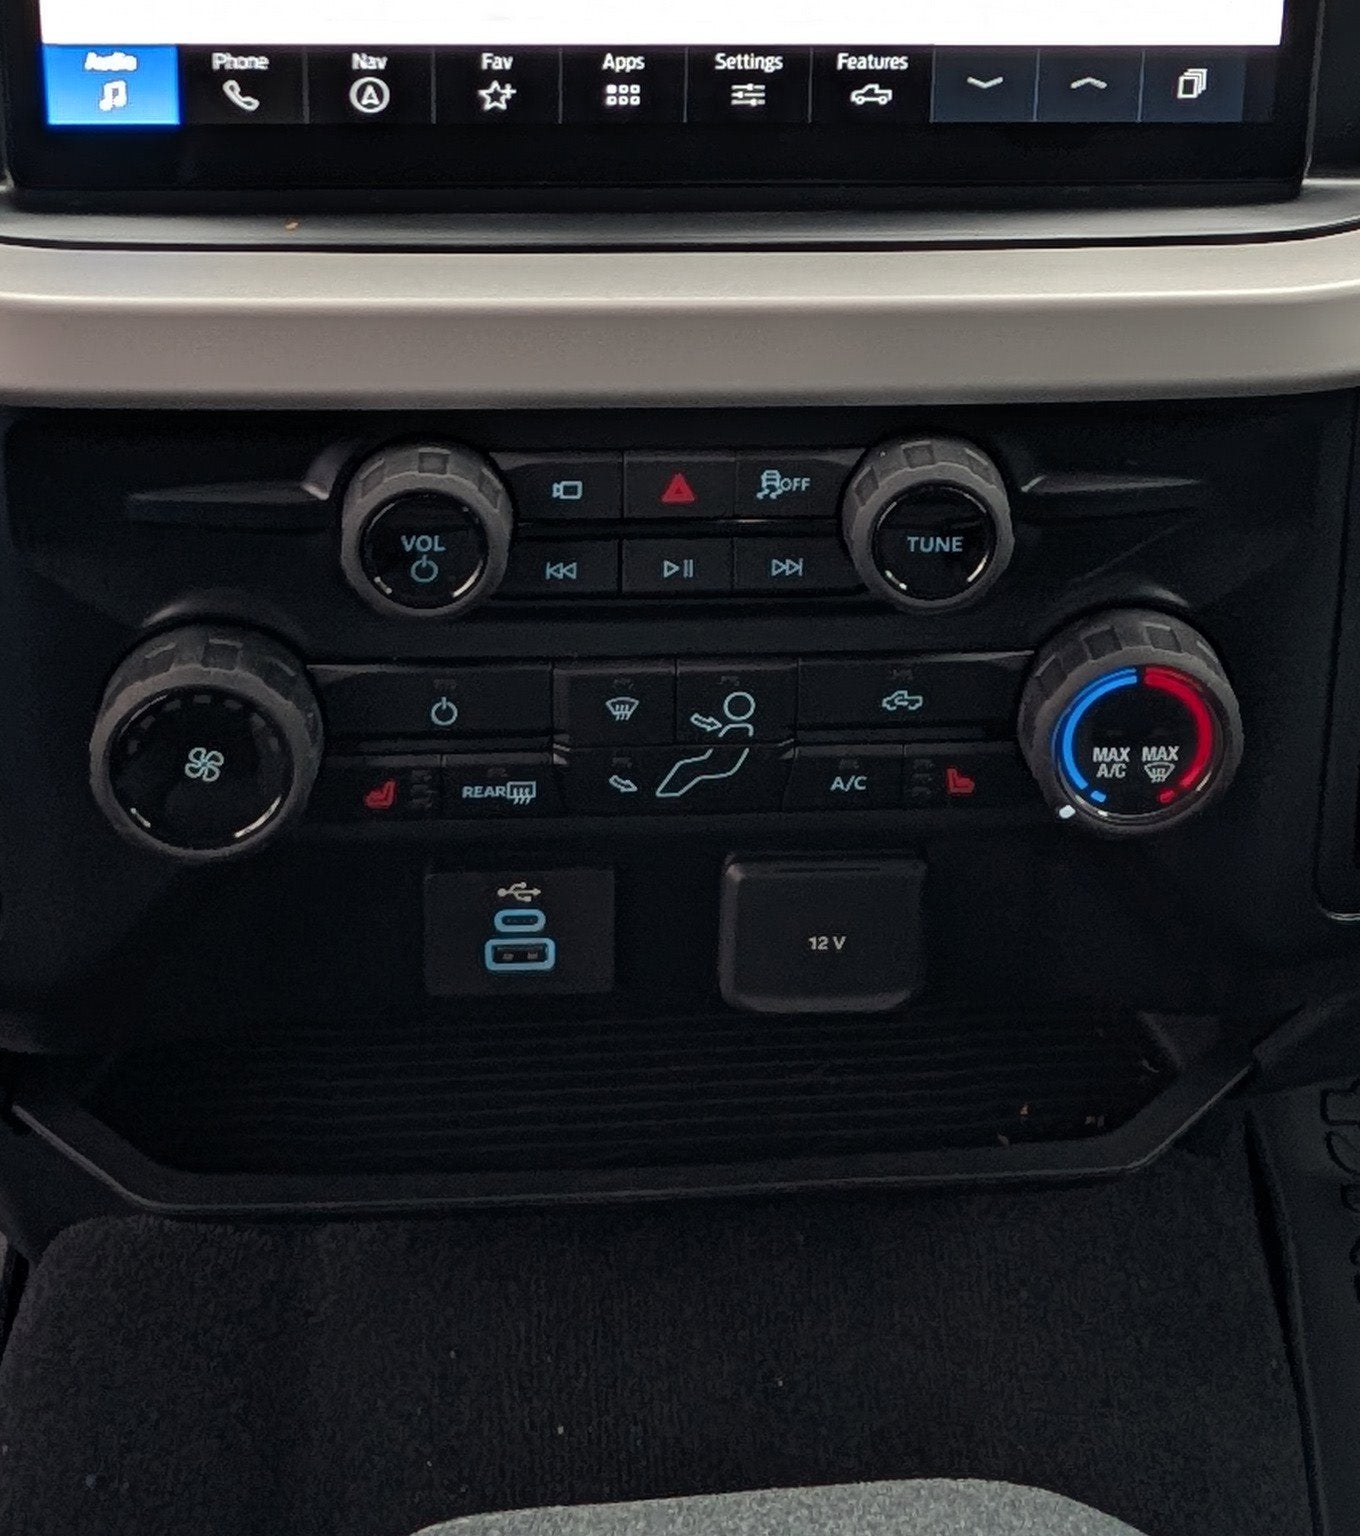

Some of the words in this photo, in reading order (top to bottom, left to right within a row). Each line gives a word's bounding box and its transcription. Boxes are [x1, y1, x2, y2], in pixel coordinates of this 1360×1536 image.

[84, 52, 137, 71] Audio
[212, 52, 270, 70] Phone
[351, 53, 388, 71] Nav
[481, 53, 514, 71] Fav
[602, 53, 645, 72] Apps
[714, 53, 784, 72] Settings
[836, 53, 909, 71] Features
[781, 476, 810, 493] OFF
[400, 535, 445, 552] VOL
[907, 536, 963, 553] TUNE
[1093, 747, 1130, 763] MAX
[1142, 745, 1179, 761] MAX
[1096, 764, 1126, 779] A/C
[462, 785, 505, 799] REAR
[831, 775, 867, 792] A/C
[808, 936, 830, 951] 12
[832, 936, 847, 950] V
